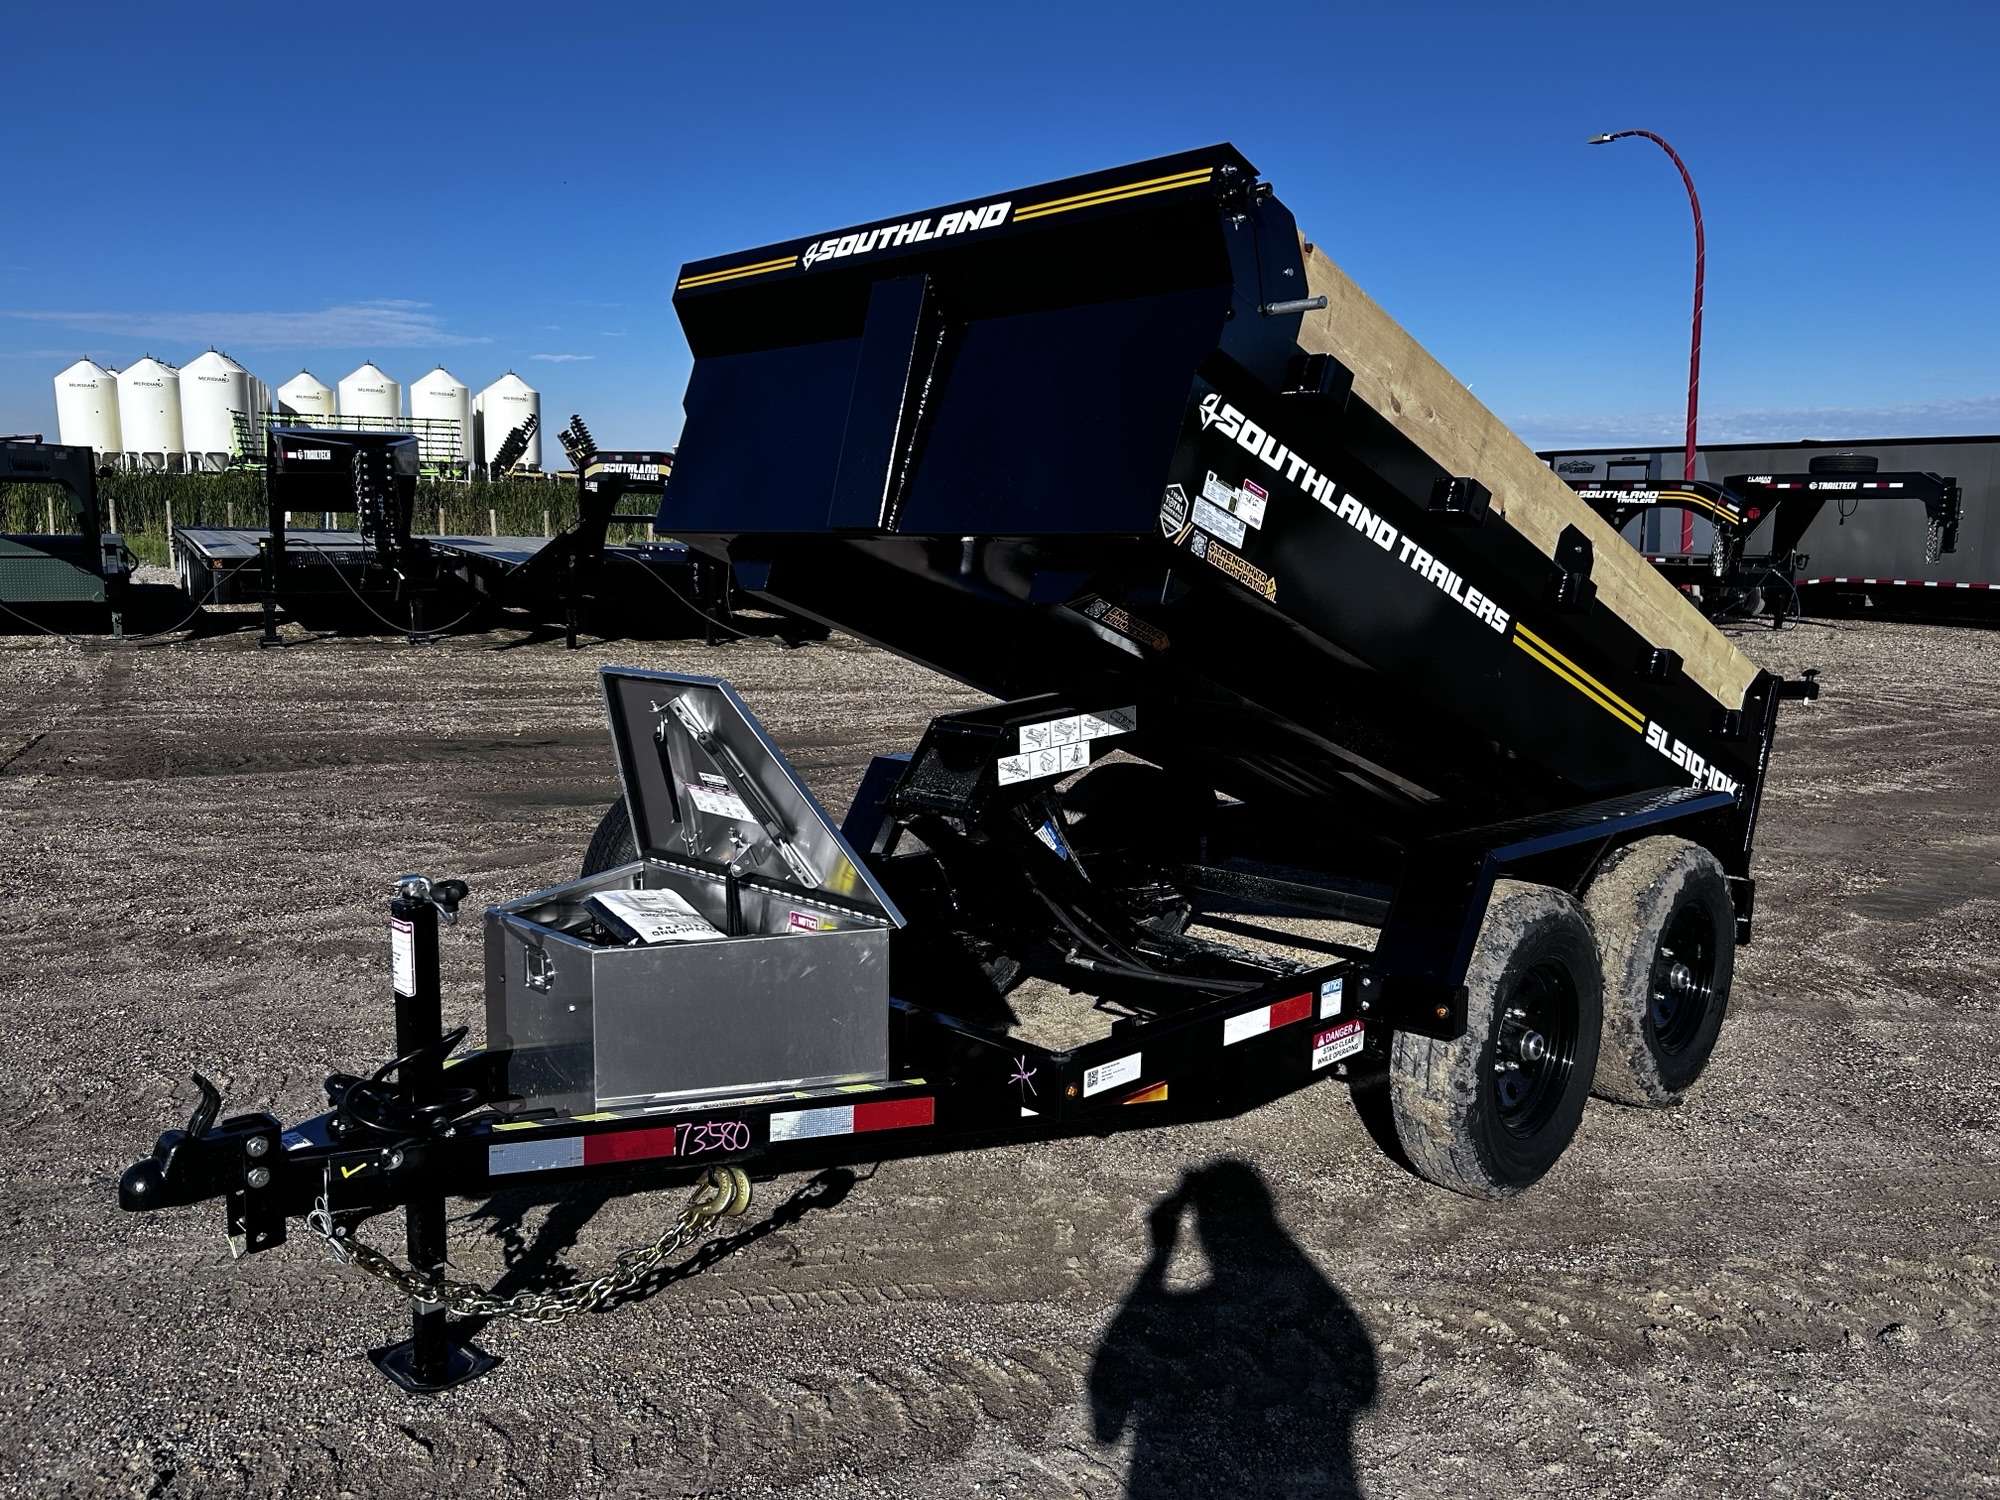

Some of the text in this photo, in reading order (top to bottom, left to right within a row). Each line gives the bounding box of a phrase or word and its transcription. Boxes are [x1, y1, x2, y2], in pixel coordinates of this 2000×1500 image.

[816, 201, 1012, 261] SOUTHLAND
[603, 463, 658, 474] SOUTHLAND
[630, 473, 660, 481] TRAILERS
[1579, 490, 1660, 499] SOUTHLAND
[1818, 482, 1858, 490] TRAILTECH
[1215, 403, 1511, 634] SOUTHLAND TRAILERS
[1208, 542, 1256, 577] STRENGTH
[1208, 552, 1266, 594] WEIGHT RATIO
[1325, 1024, 1353, 1042] DANGER
[1323, 1036, 1355, 1054] STAND CLEAR
[1333, 1043, 1359, 1060] OPERATING
[676, 1121, 750, 1156] 73580
